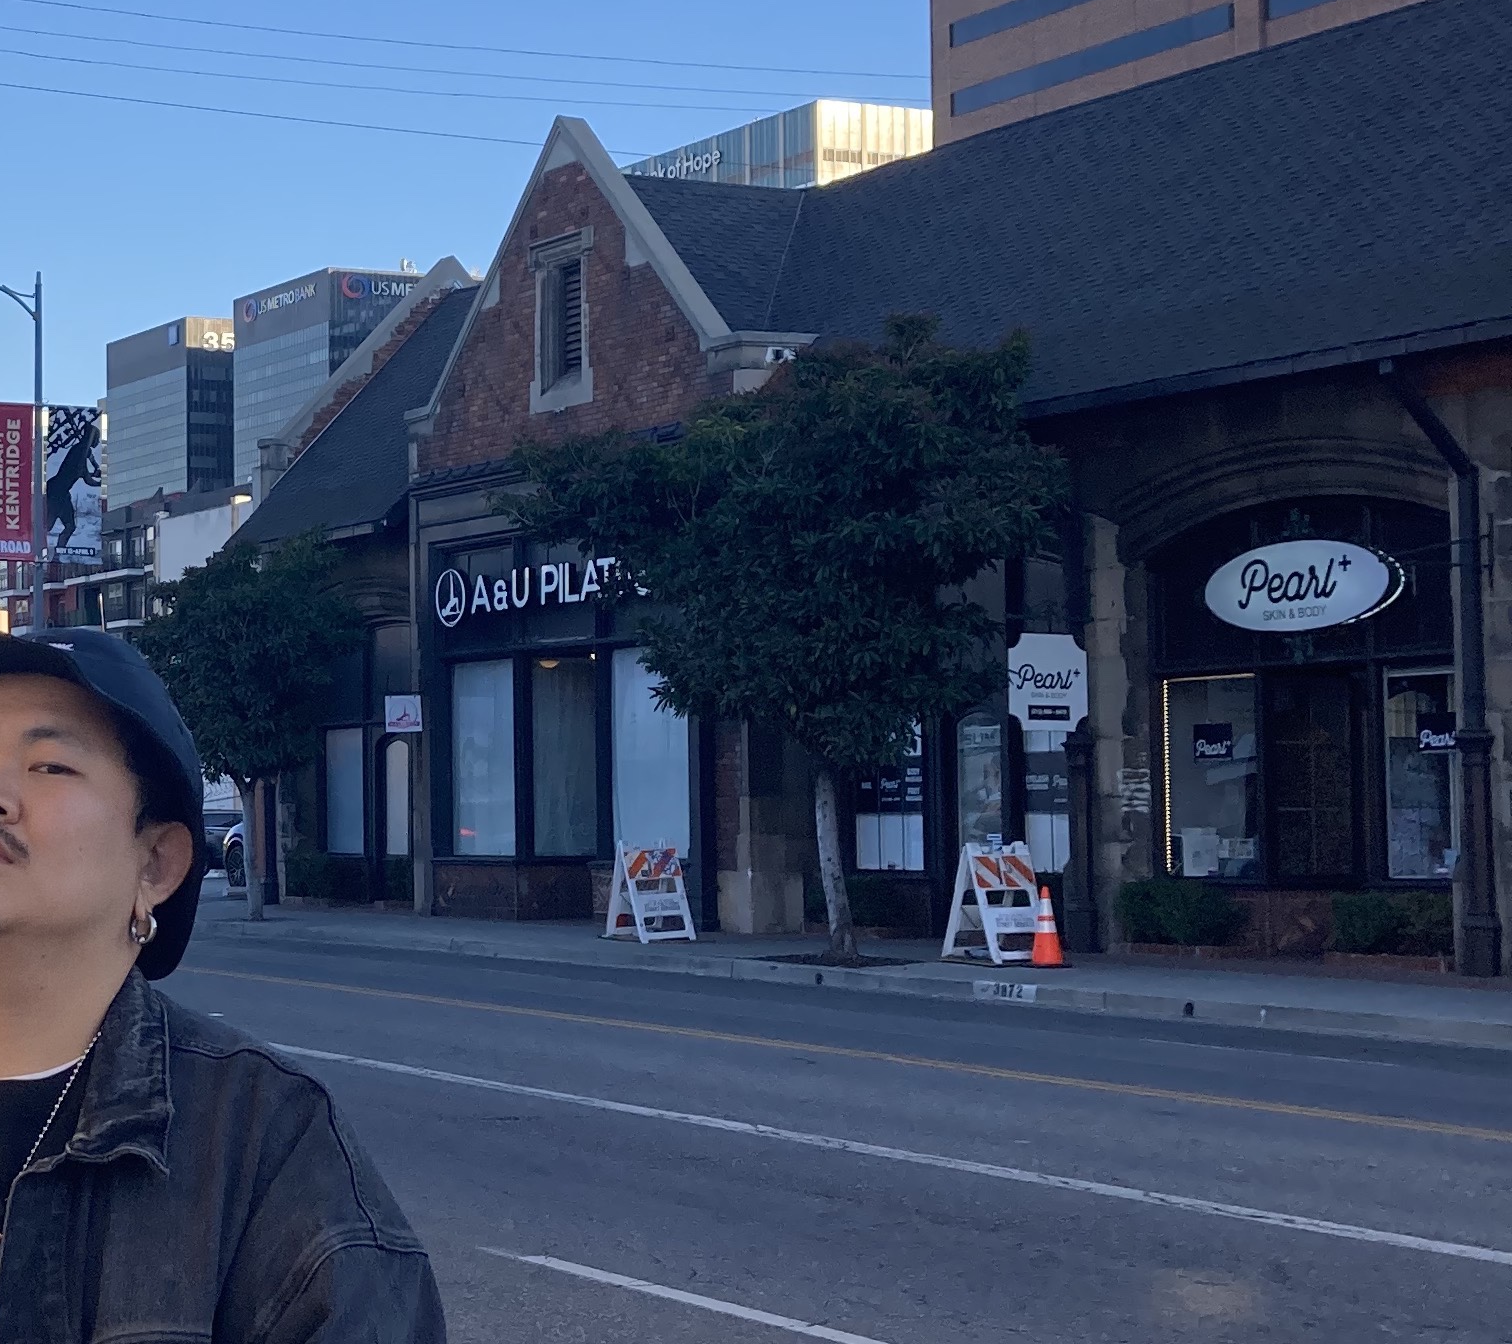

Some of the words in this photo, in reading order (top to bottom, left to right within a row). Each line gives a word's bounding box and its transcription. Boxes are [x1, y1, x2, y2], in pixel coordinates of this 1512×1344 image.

[683, 150, 721, 175] Hope
[257, 299, 267, 315] US
[267, 290, 295, 312] METRO
[294, 283, 317, 303] BANK
[371, 281, 390, 296] US
[391, 283, 418, 297] ME
[202, 331, 235, 352] 35
[6, 418, 21, 530] KENTRIDGE
[471, 566, 530, 614] A&U
[540, 557, 651, 606] PILAT
[1263, 609, 1286, 621] SKIN
[1288, 608, 1296, 620] &
[1298, 604, 1327, 618] BODY
